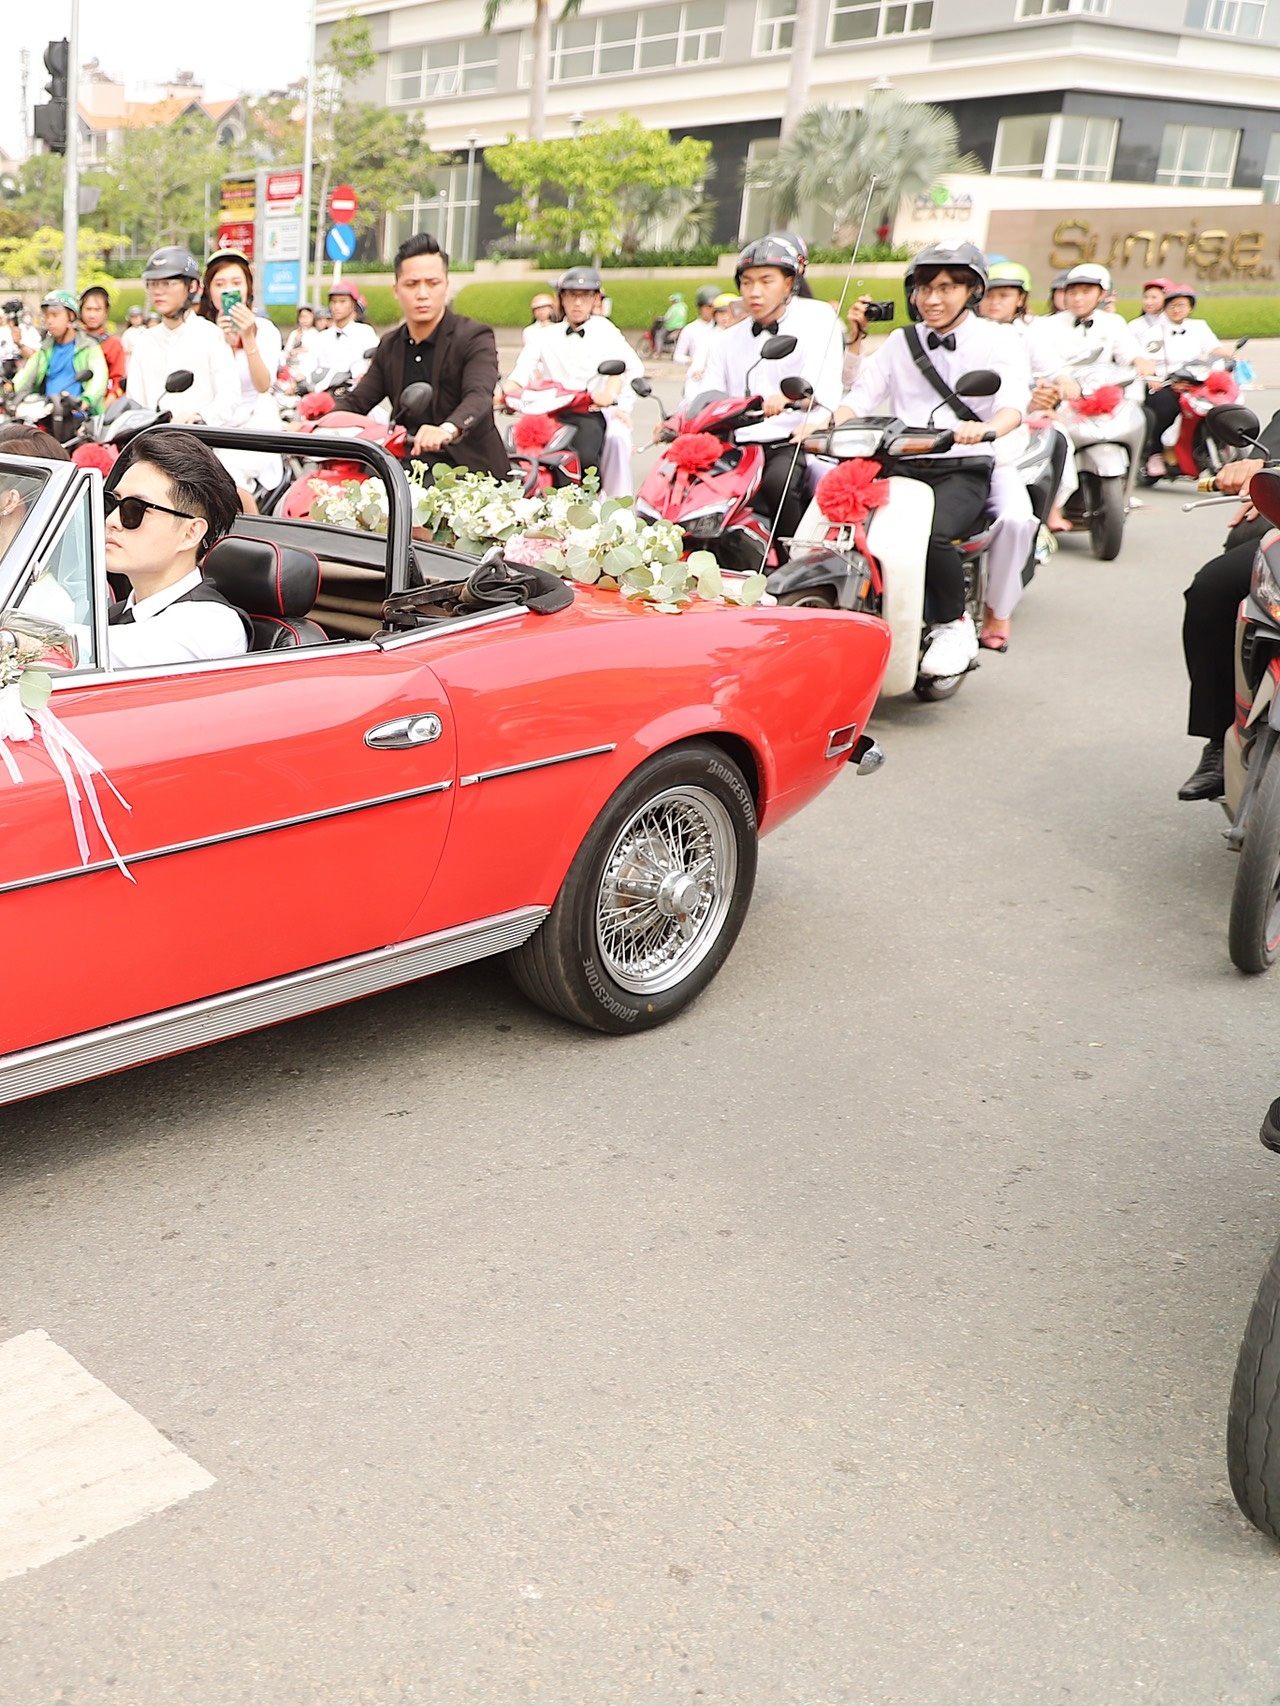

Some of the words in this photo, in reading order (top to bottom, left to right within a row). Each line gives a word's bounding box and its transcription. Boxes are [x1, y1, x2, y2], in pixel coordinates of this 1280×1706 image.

[1050, 218, 1265, 269] Sunrise
[706, 758, 756, 832] BRIDGESTONE
[582, 956, 640, 1024] BRIDGESTONE
